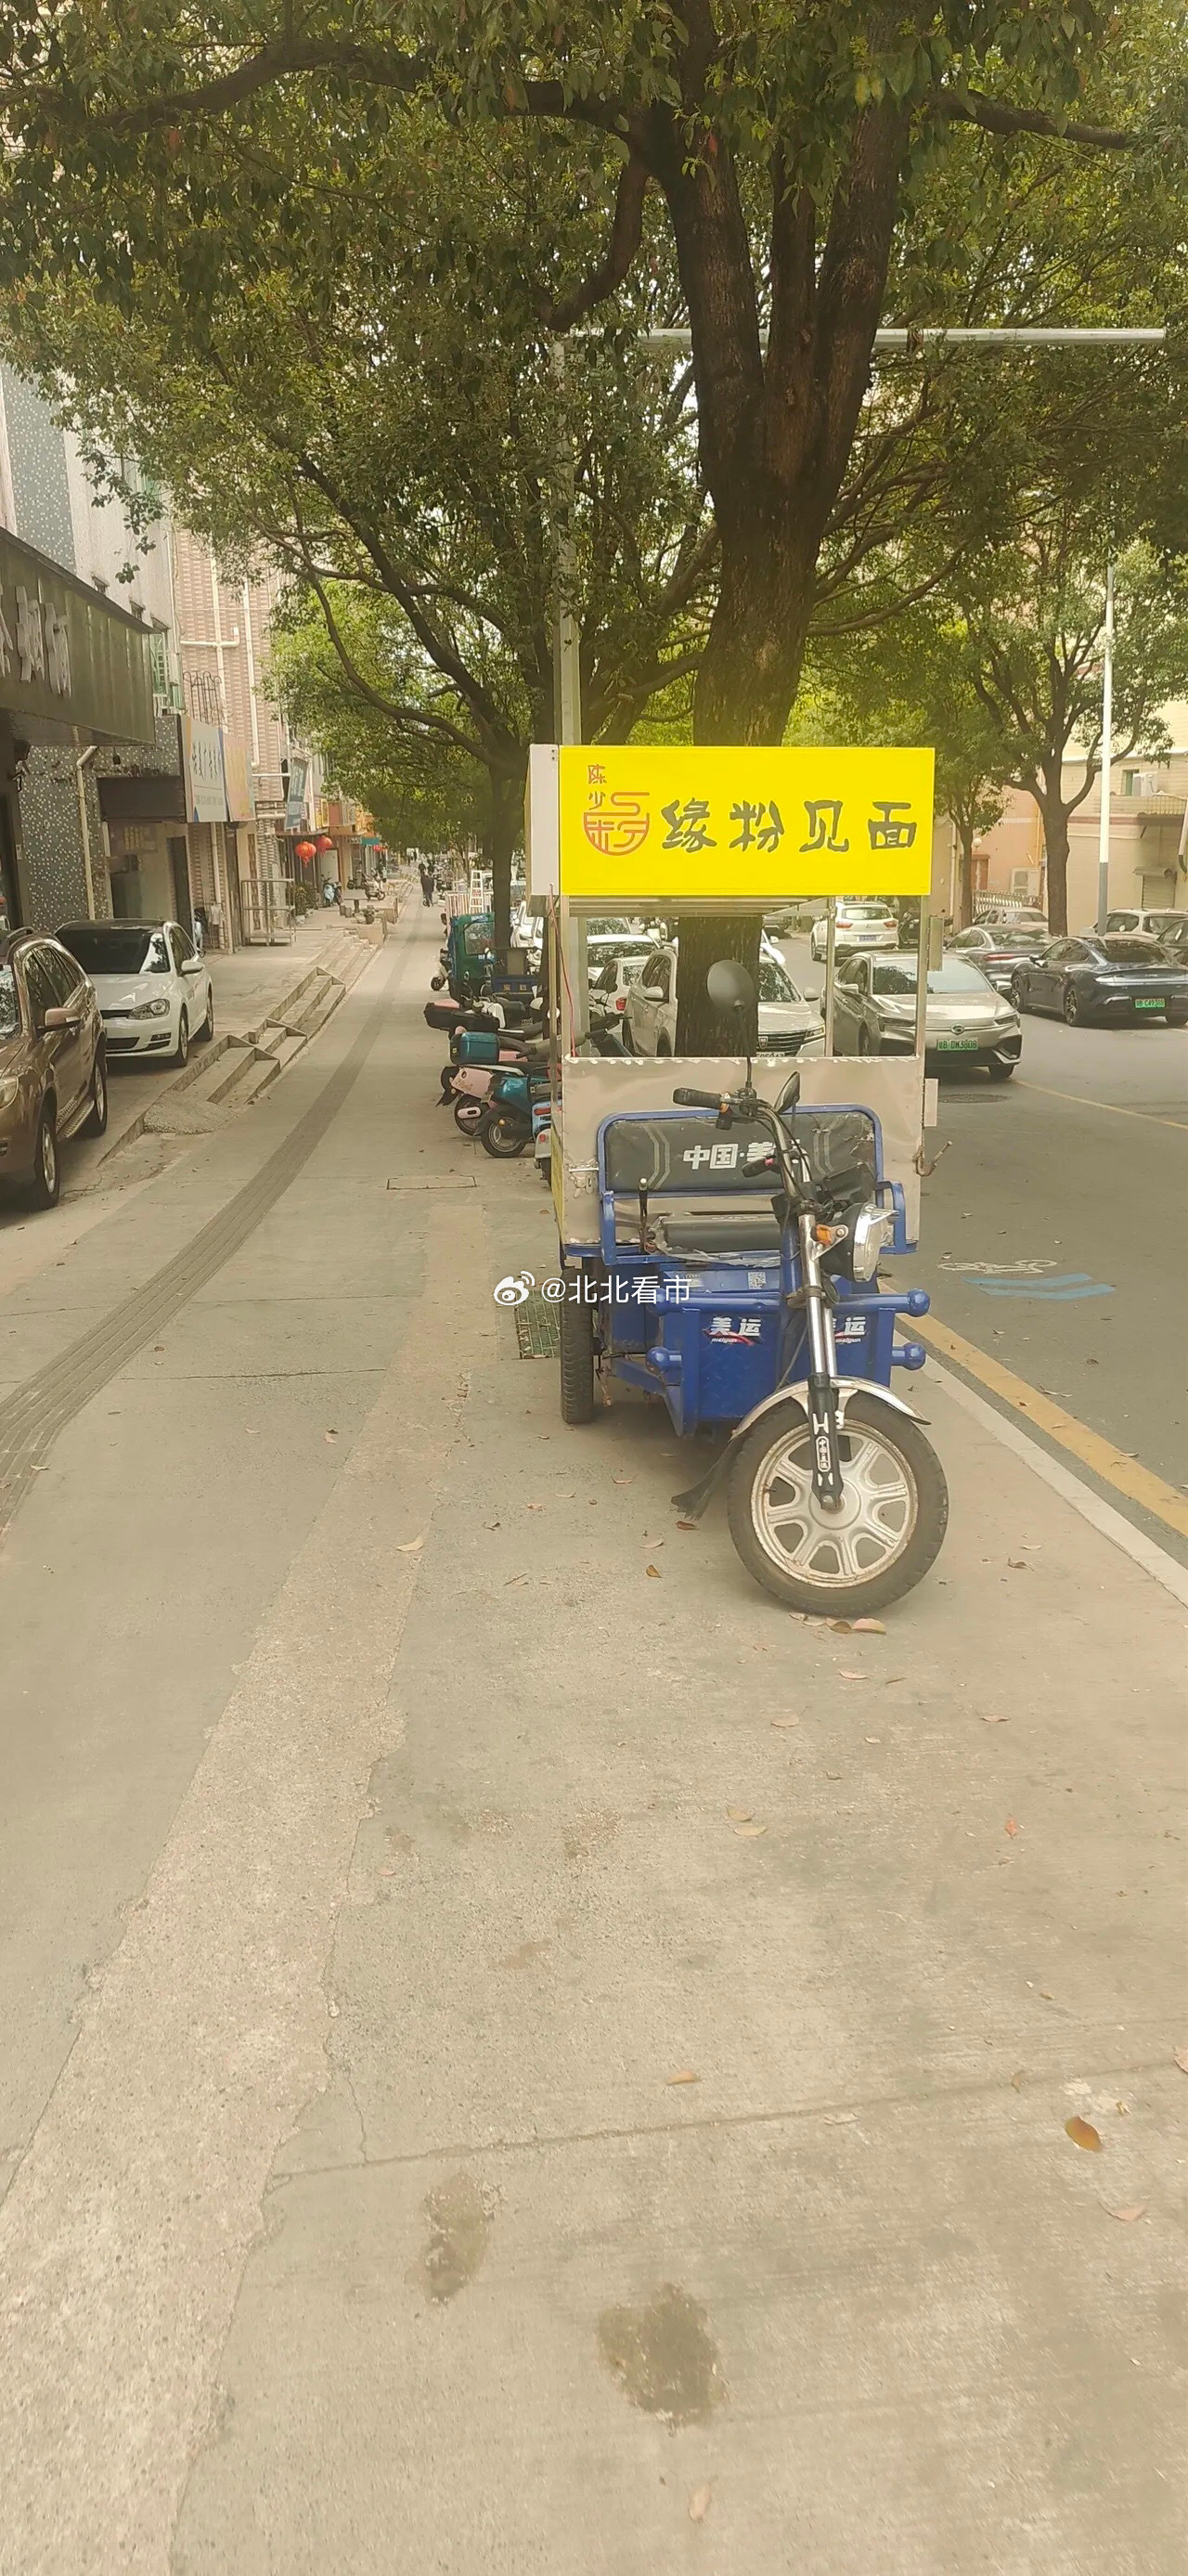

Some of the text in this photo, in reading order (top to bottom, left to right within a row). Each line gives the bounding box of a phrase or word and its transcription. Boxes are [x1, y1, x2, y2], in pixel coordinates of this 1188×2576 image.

[661, 796, 918, 854] 缘粉见面
[709, 1316, 762, 1337] 美运
[832, 1316, 867, 1337] 运
